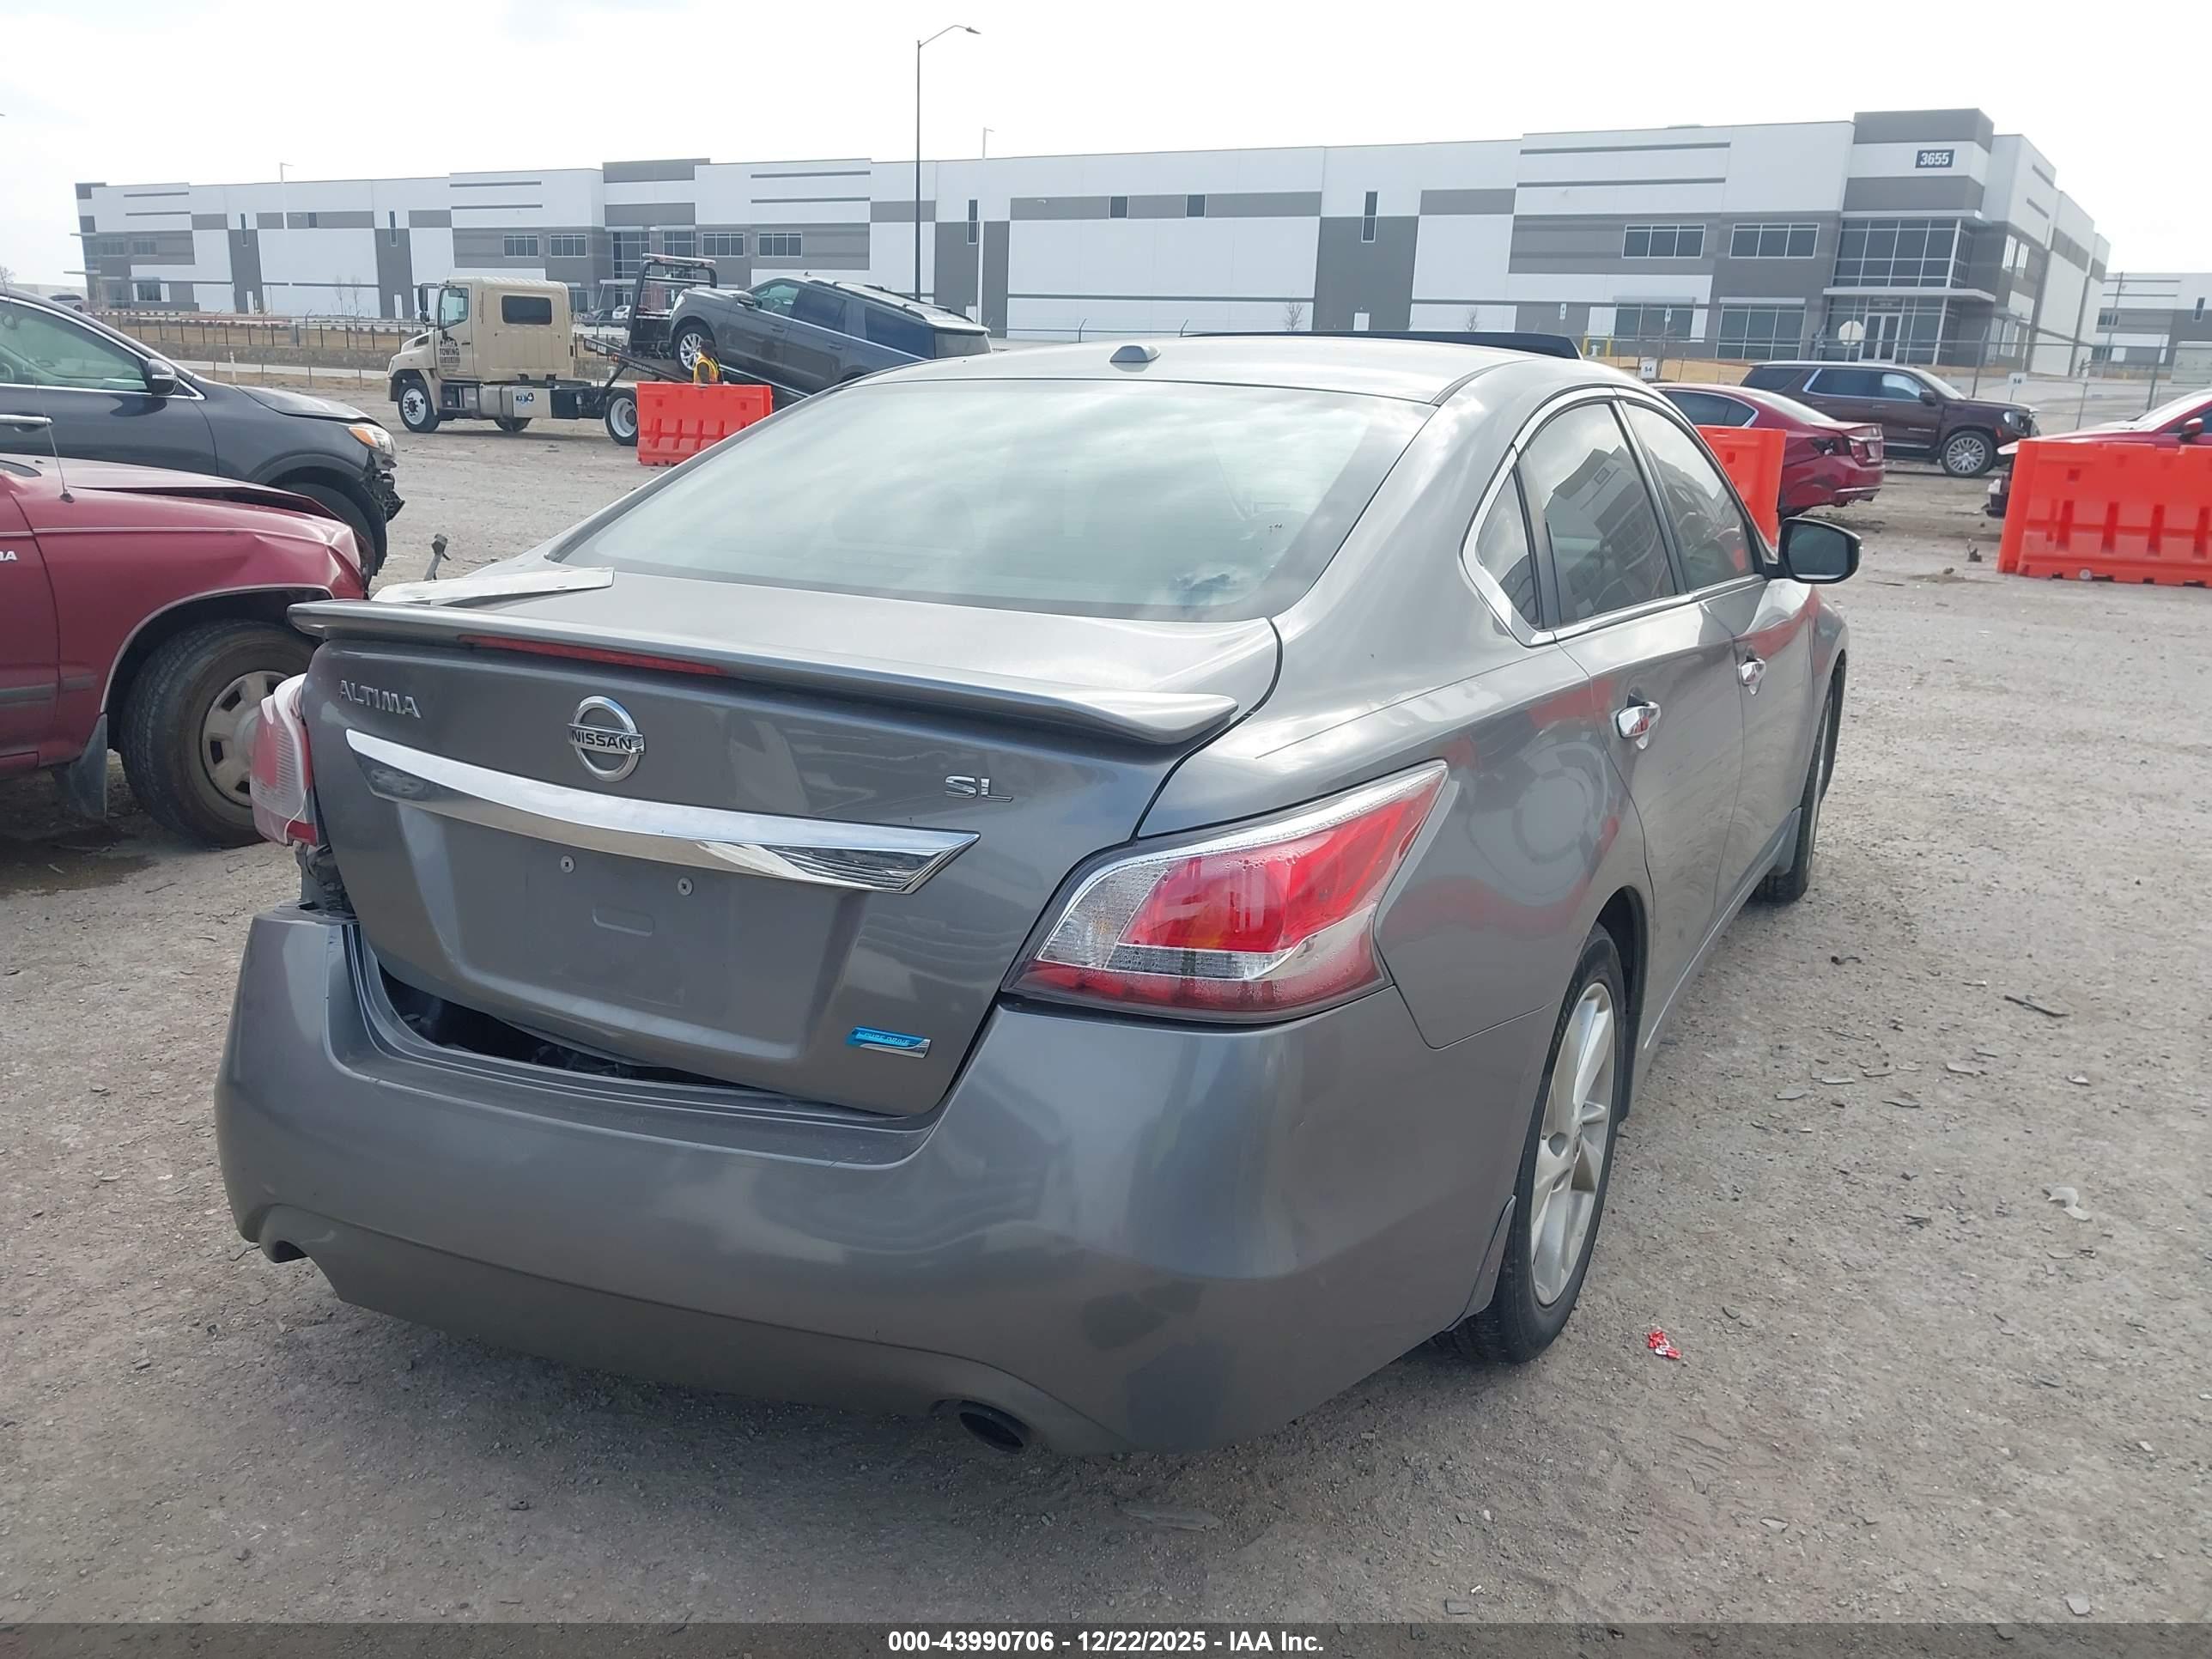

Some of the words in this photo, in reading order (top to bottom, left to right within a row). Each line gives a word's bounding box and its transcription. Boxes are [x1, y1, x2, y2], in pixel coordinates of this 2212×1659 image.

[1920, 152, 1950, 166] 3655
[439, 348, 460, 356] TOWING
[339, 679, 422, 719] ALTIMA
[571, 729, 633, 750] NISSAN
[945, 775, 1013, 802] SL
